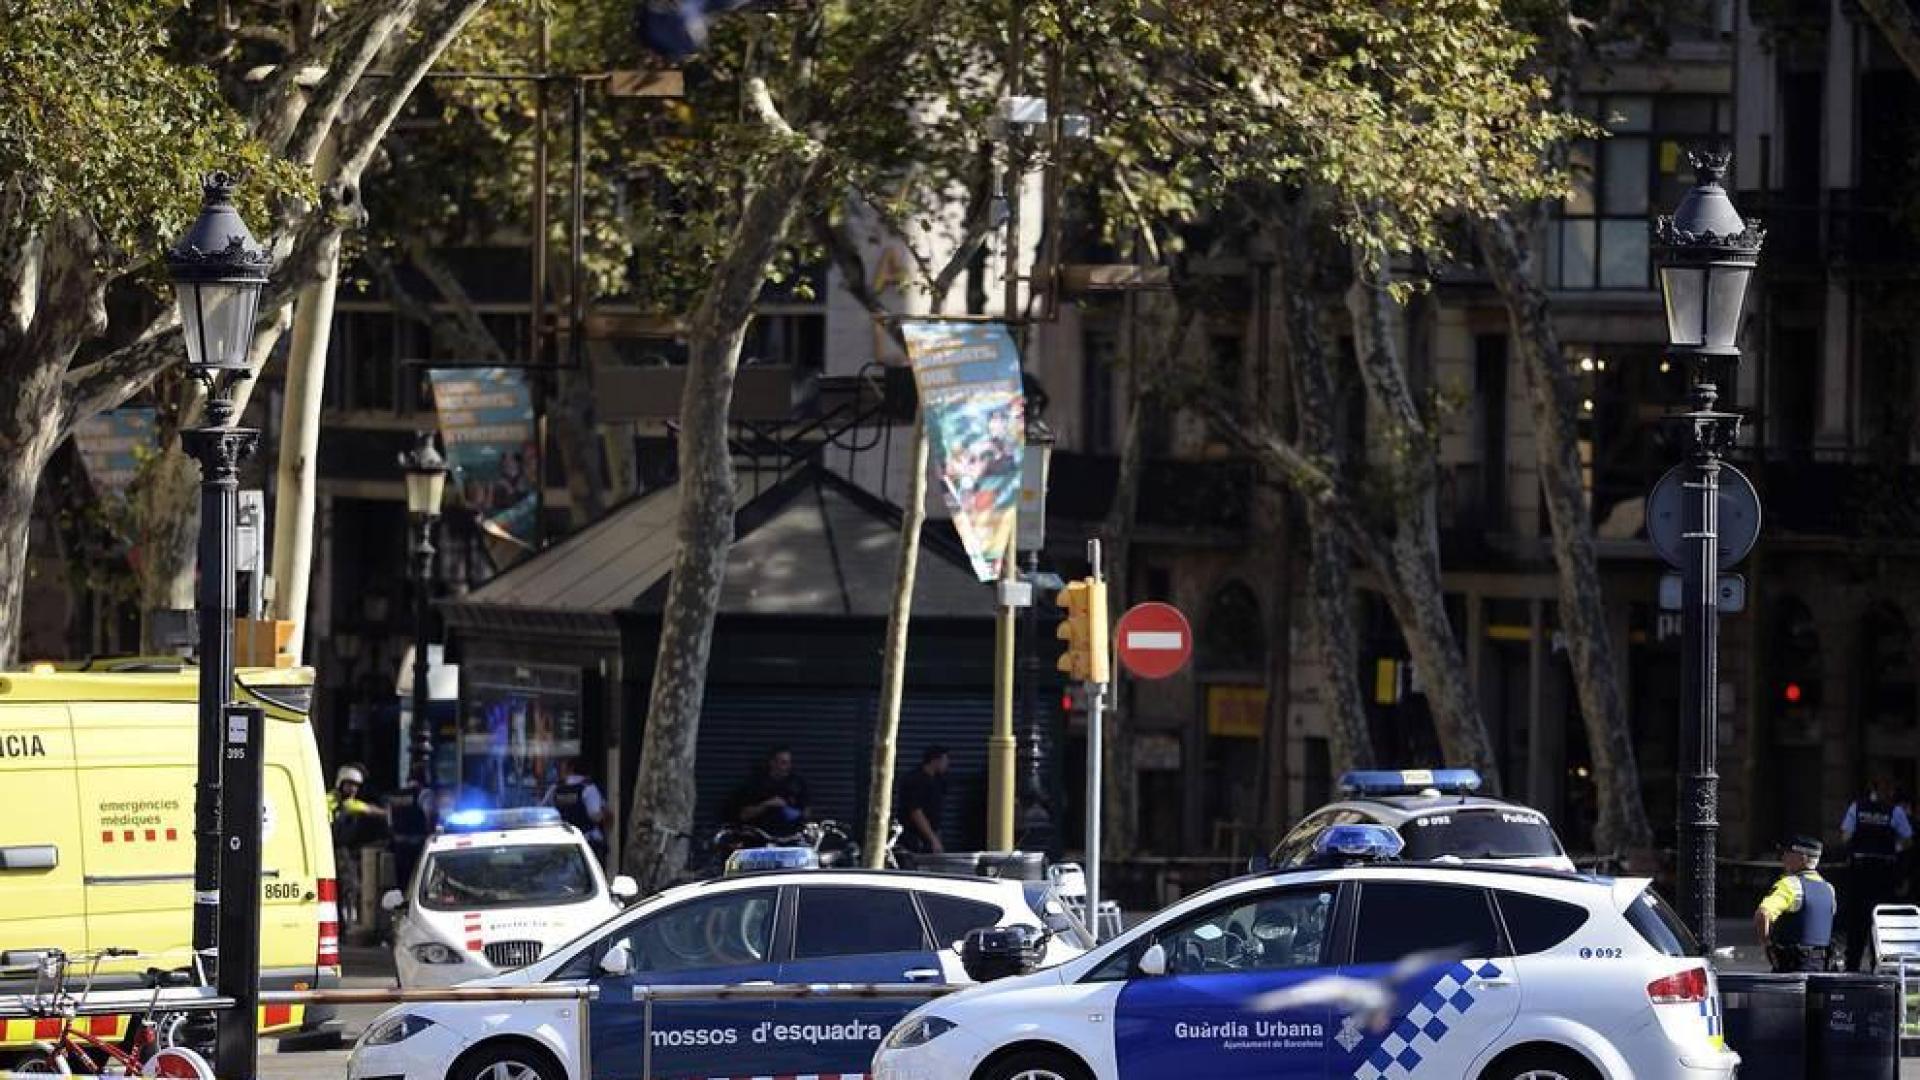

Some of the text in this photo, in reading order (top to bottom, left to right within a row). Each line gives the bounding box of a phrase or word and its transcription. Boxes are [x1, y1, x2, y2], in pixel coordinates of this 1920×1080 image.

[0, 734, 46, 758] CIA
[264, 883, 300, 899] 8606
[1595, 947, 1622, 959] 092
[651, 1019, 882, 1046] mossos d'esquadra
[1174, 1020, 1324, 1038] Guàrdia Urbana
